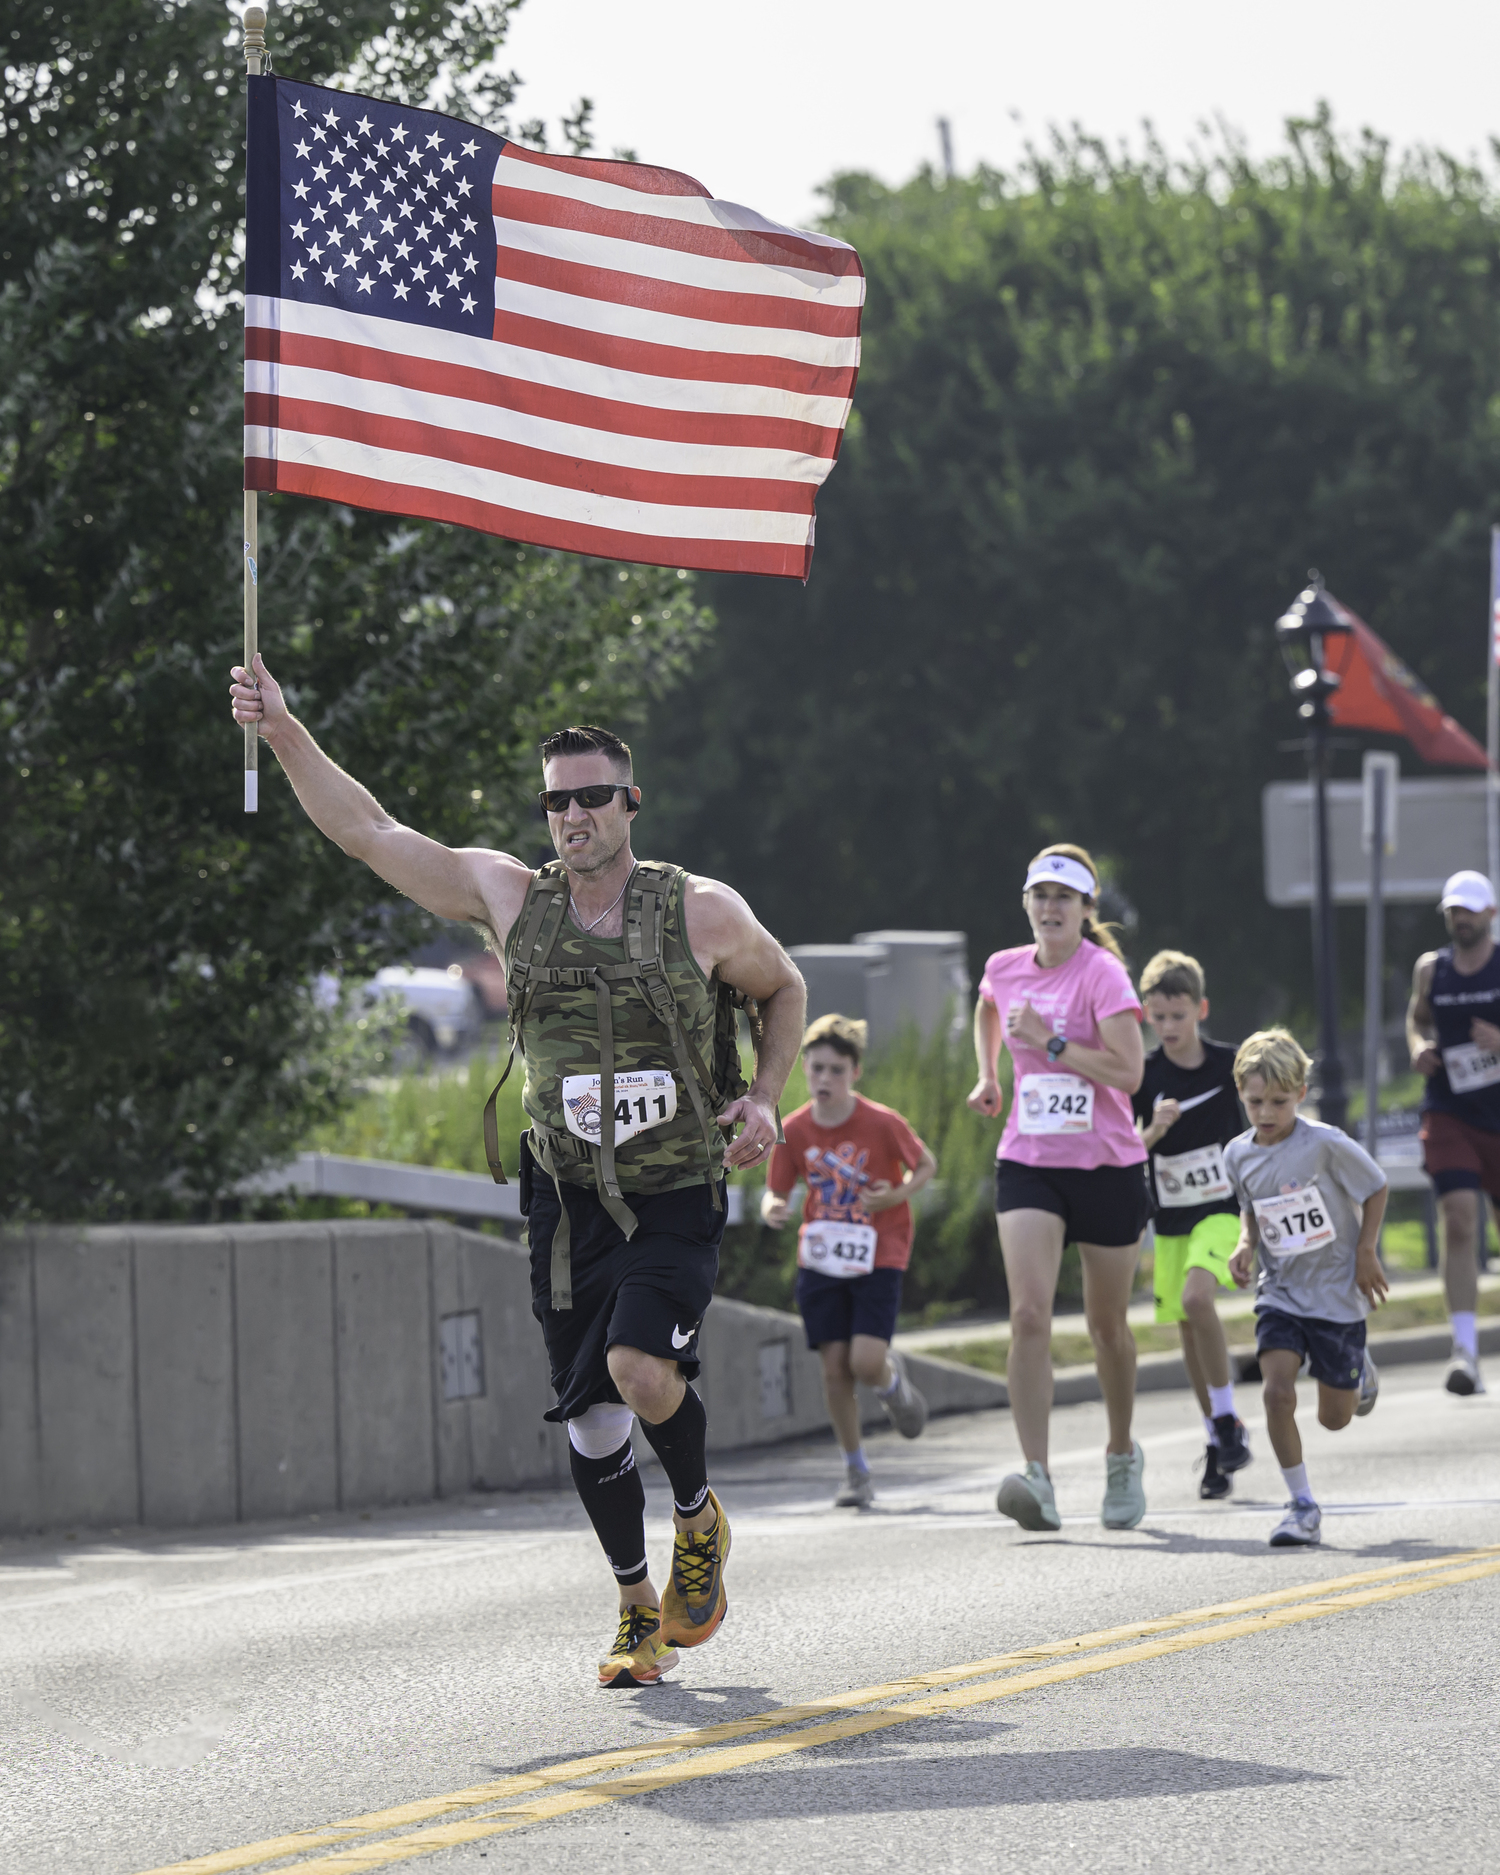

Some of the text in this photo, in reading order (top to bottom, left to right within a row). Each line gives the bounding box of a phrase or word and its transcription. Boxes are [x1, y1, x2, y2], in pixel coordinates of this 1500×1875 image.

[592, 1076, 644, 1087] Jon's Run
[614, 1094, 667, 1126] 411
[1048, 1094, 1088, 1115] 242
[1185, 1164, 1221, 1188] 431
[1280, 1208, 1324, 1236] 176
[832, 1241, 869, 1263] 432
